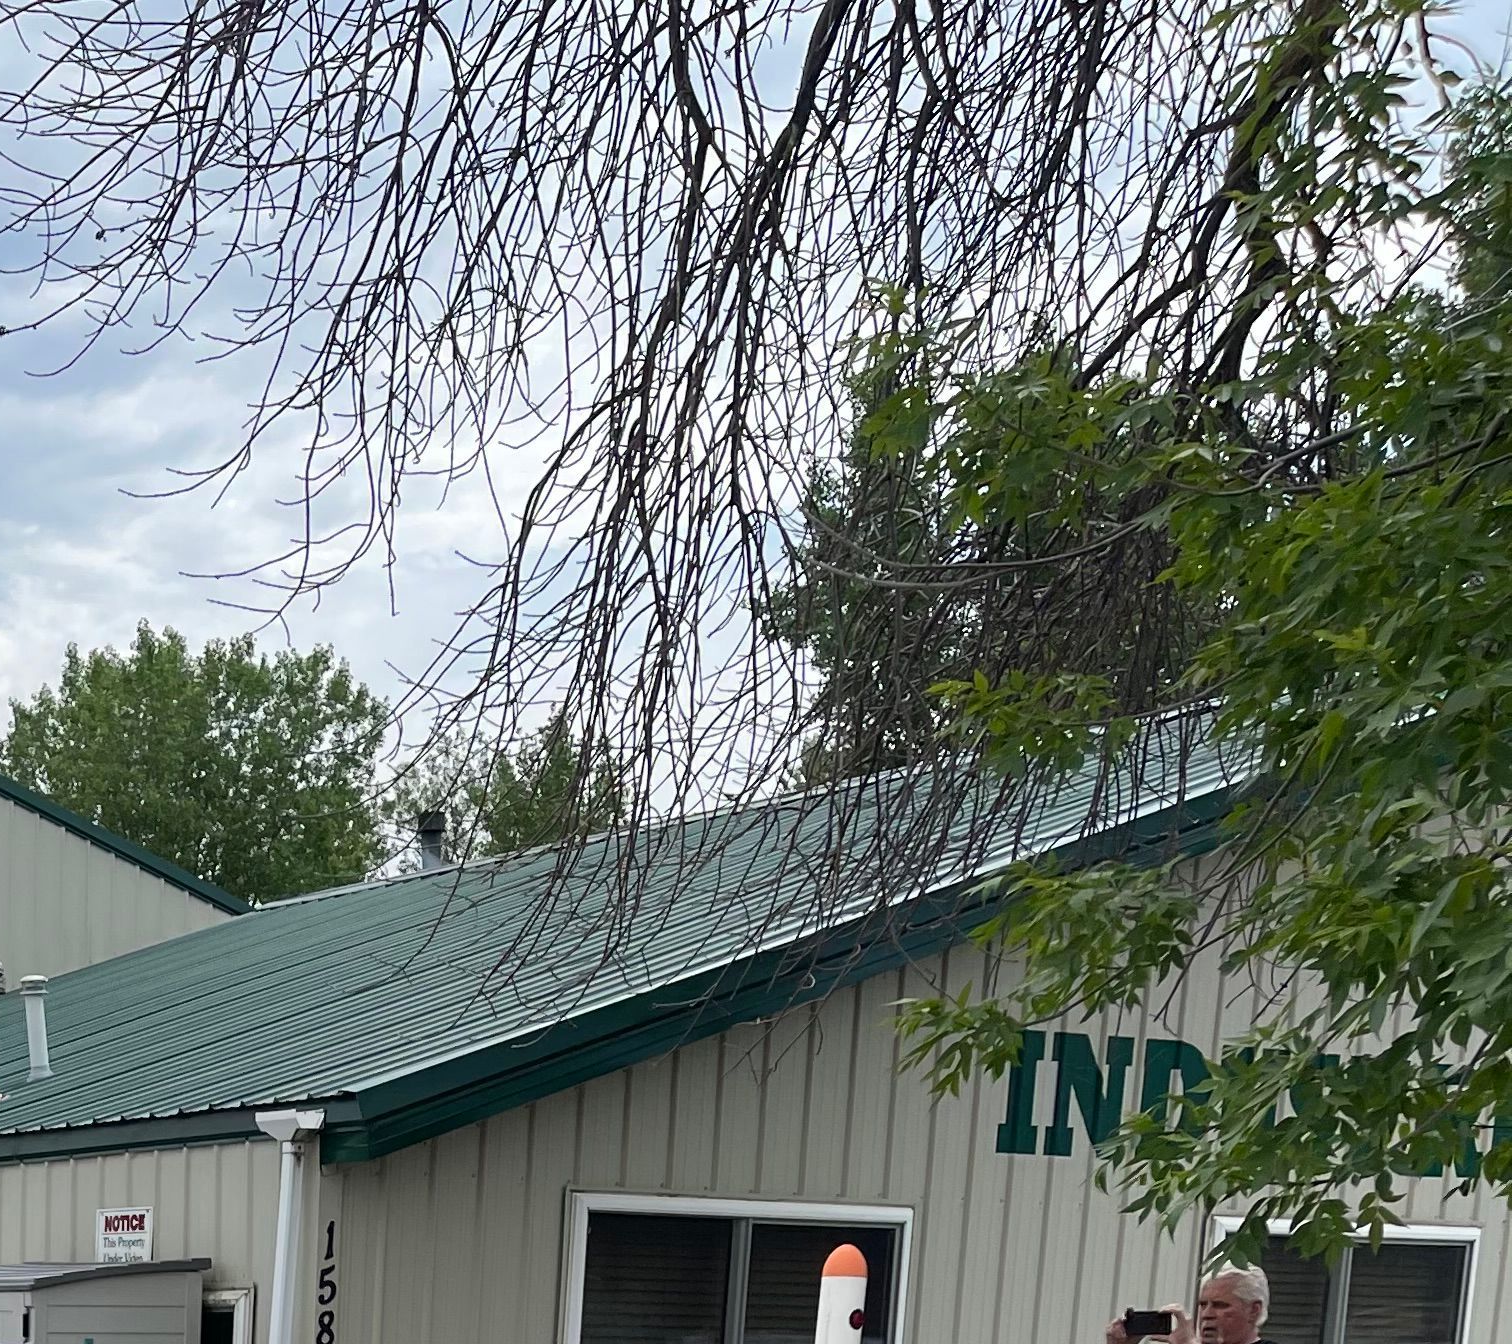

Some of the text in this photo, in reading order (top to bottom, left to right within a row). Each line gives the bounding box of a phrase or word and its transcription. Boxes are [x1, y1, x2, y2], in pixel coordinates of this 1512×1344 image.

[104, 1214, 145, 1232] NOTICE
[103, 1236, 145, 1249] This Property
